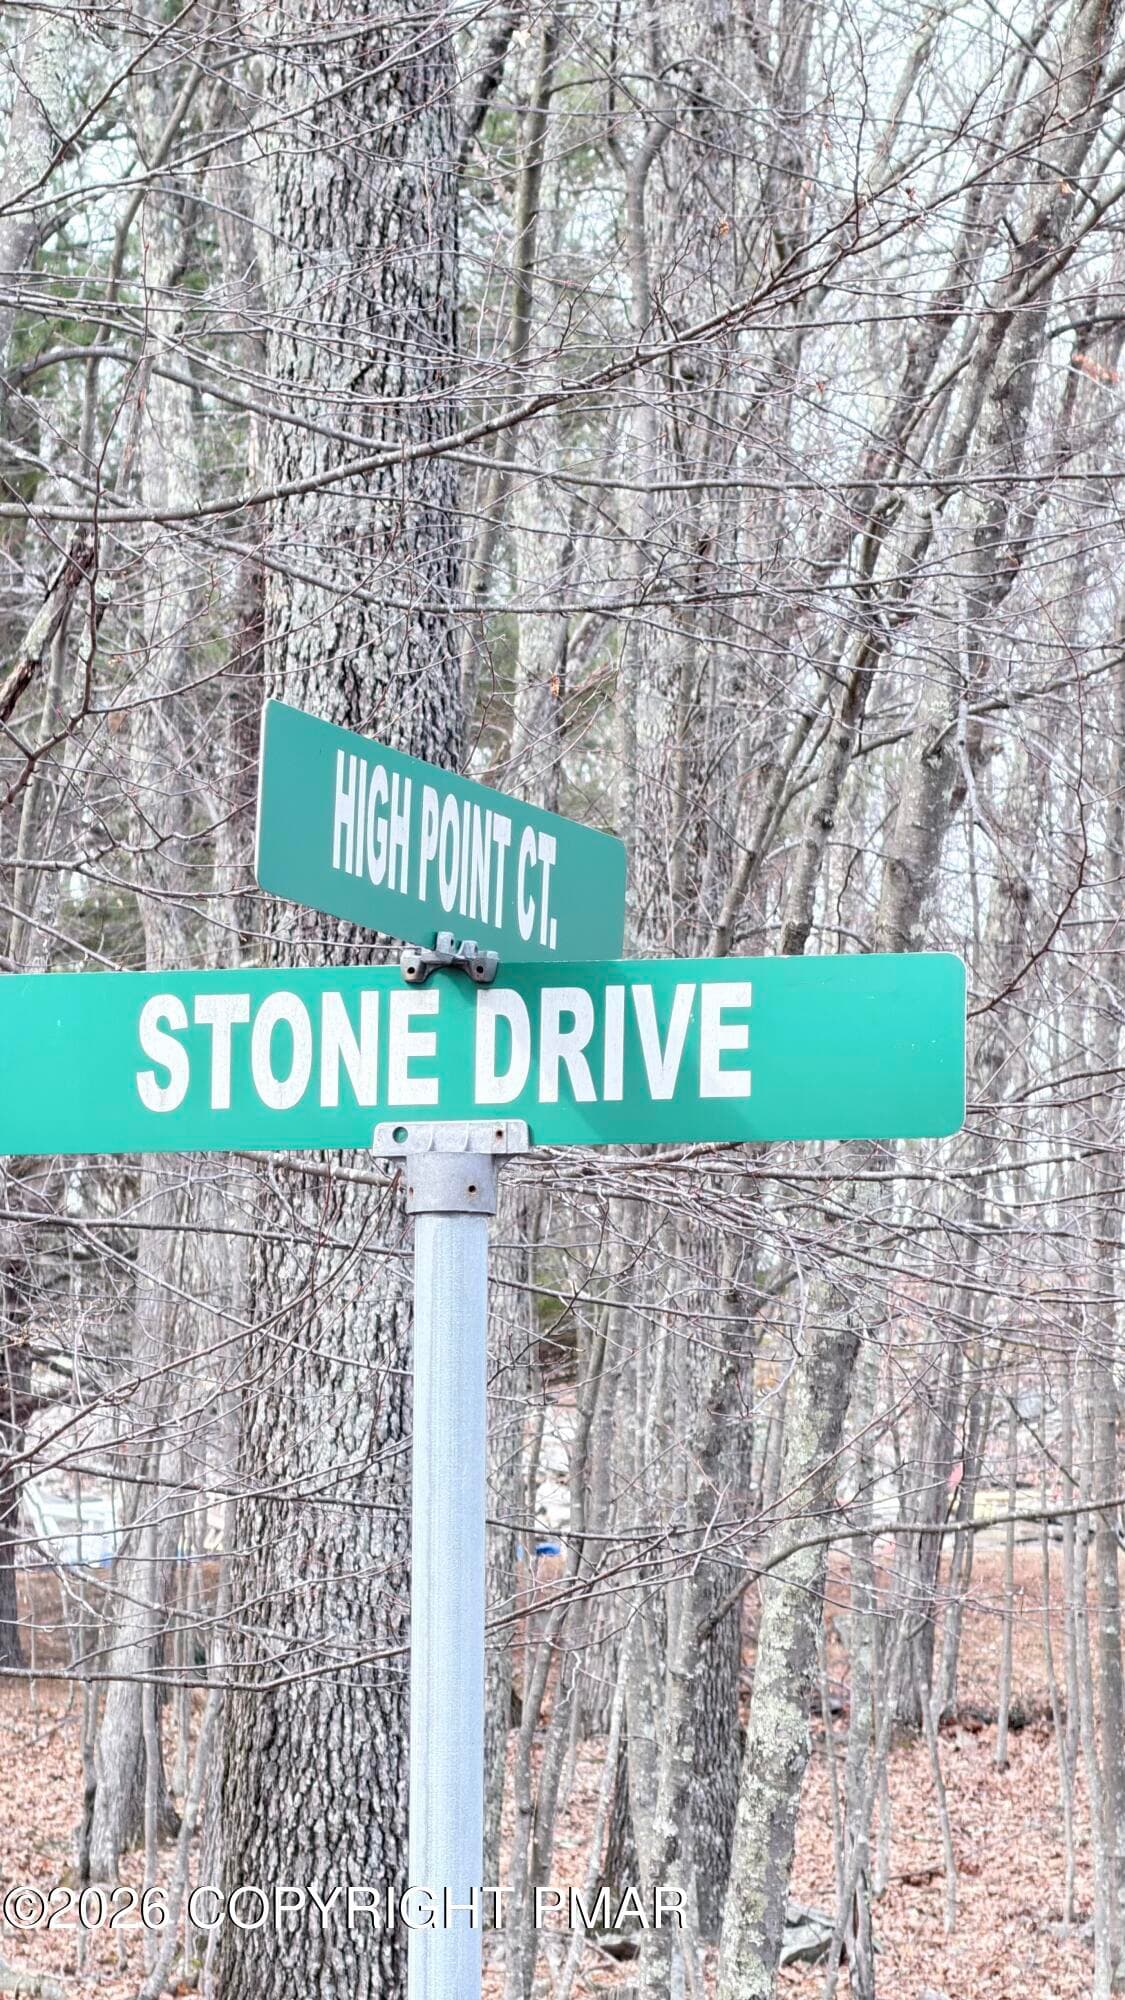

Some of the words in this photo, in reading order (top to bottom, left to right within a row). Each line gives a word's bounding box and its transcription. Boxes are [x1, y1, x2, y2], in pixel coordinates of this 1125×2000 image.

[332, 749, 412, 894] HIGH
[418, 784, 512, 929] POINT
[517, 825, 558, 950] CT.
[135, 989, 440, 1113] STONE
[474, 981, 752, 1105] DRIVE
